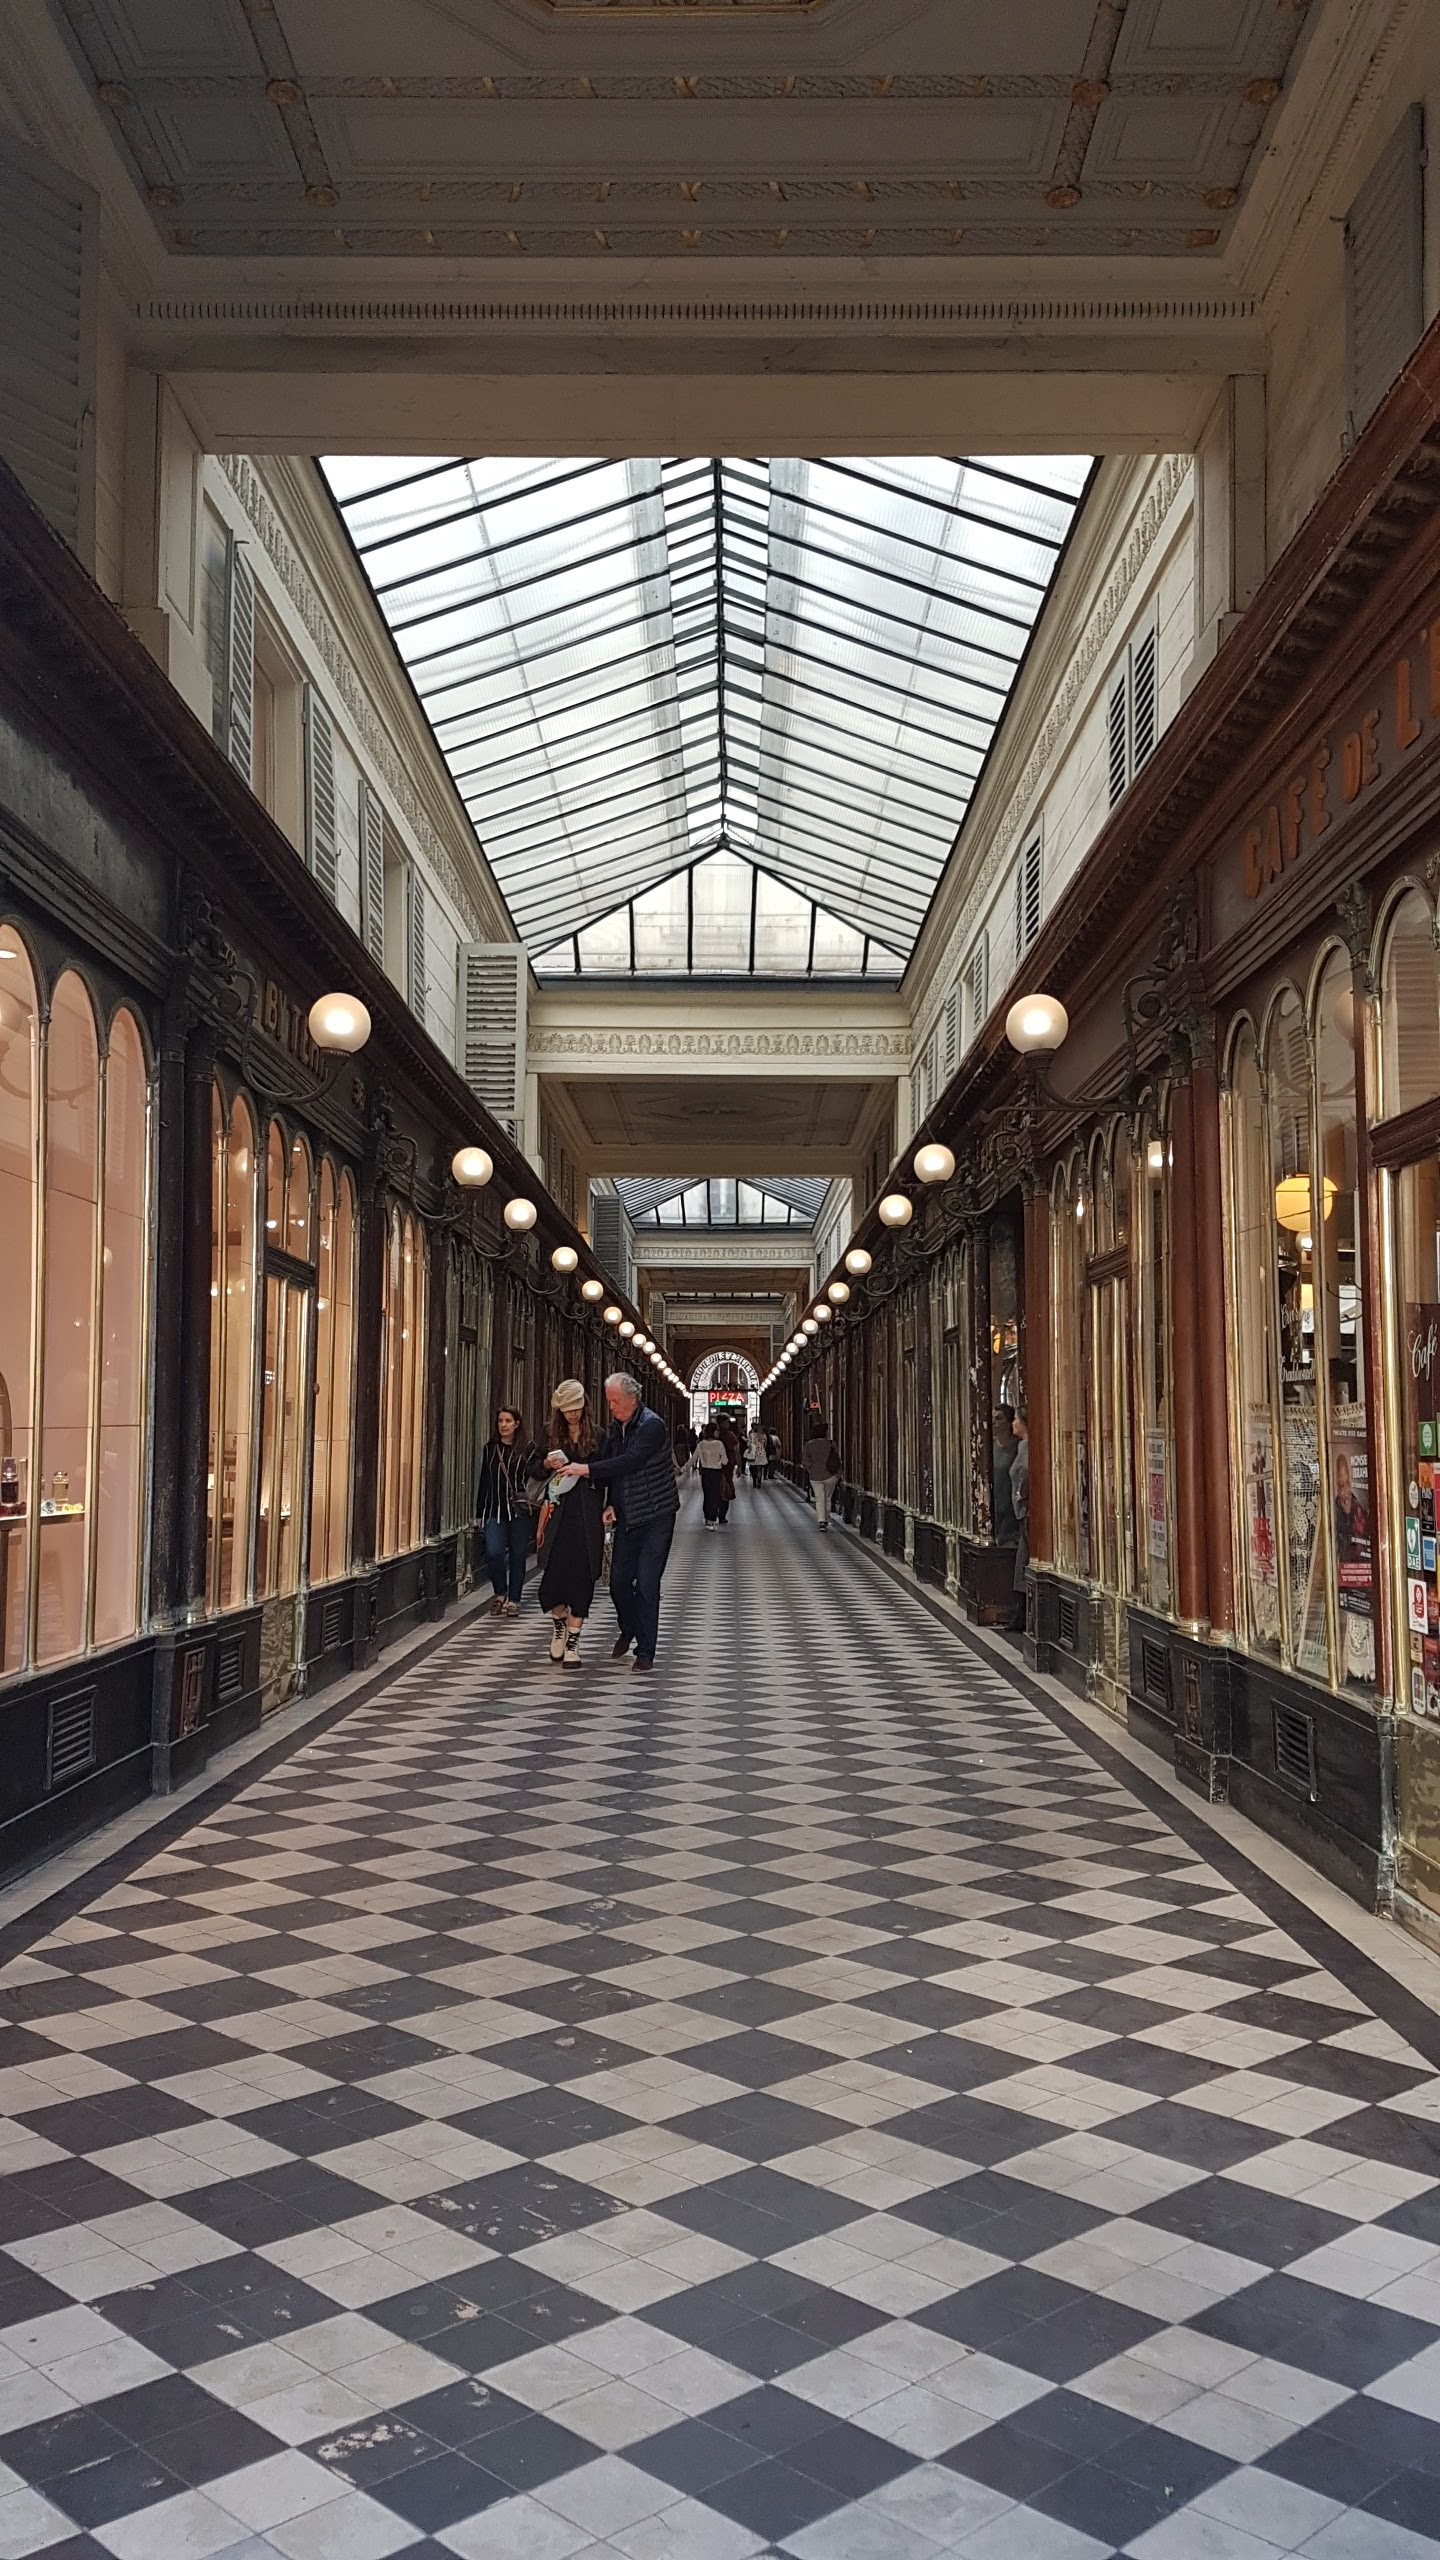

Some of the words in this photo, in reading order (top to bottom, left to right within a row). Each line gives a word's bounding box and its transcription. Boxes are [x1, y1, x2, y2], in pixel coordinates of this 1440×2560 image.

[1243, 739, 1332, 900] CAFÉ
[1340, 708, 1382, 804] DE
[1407, 1322, 1438, 1381] Café
[709, 1391, 745, 1403] PIZZA
[1408, 1555, 1420, 1567] DAE
